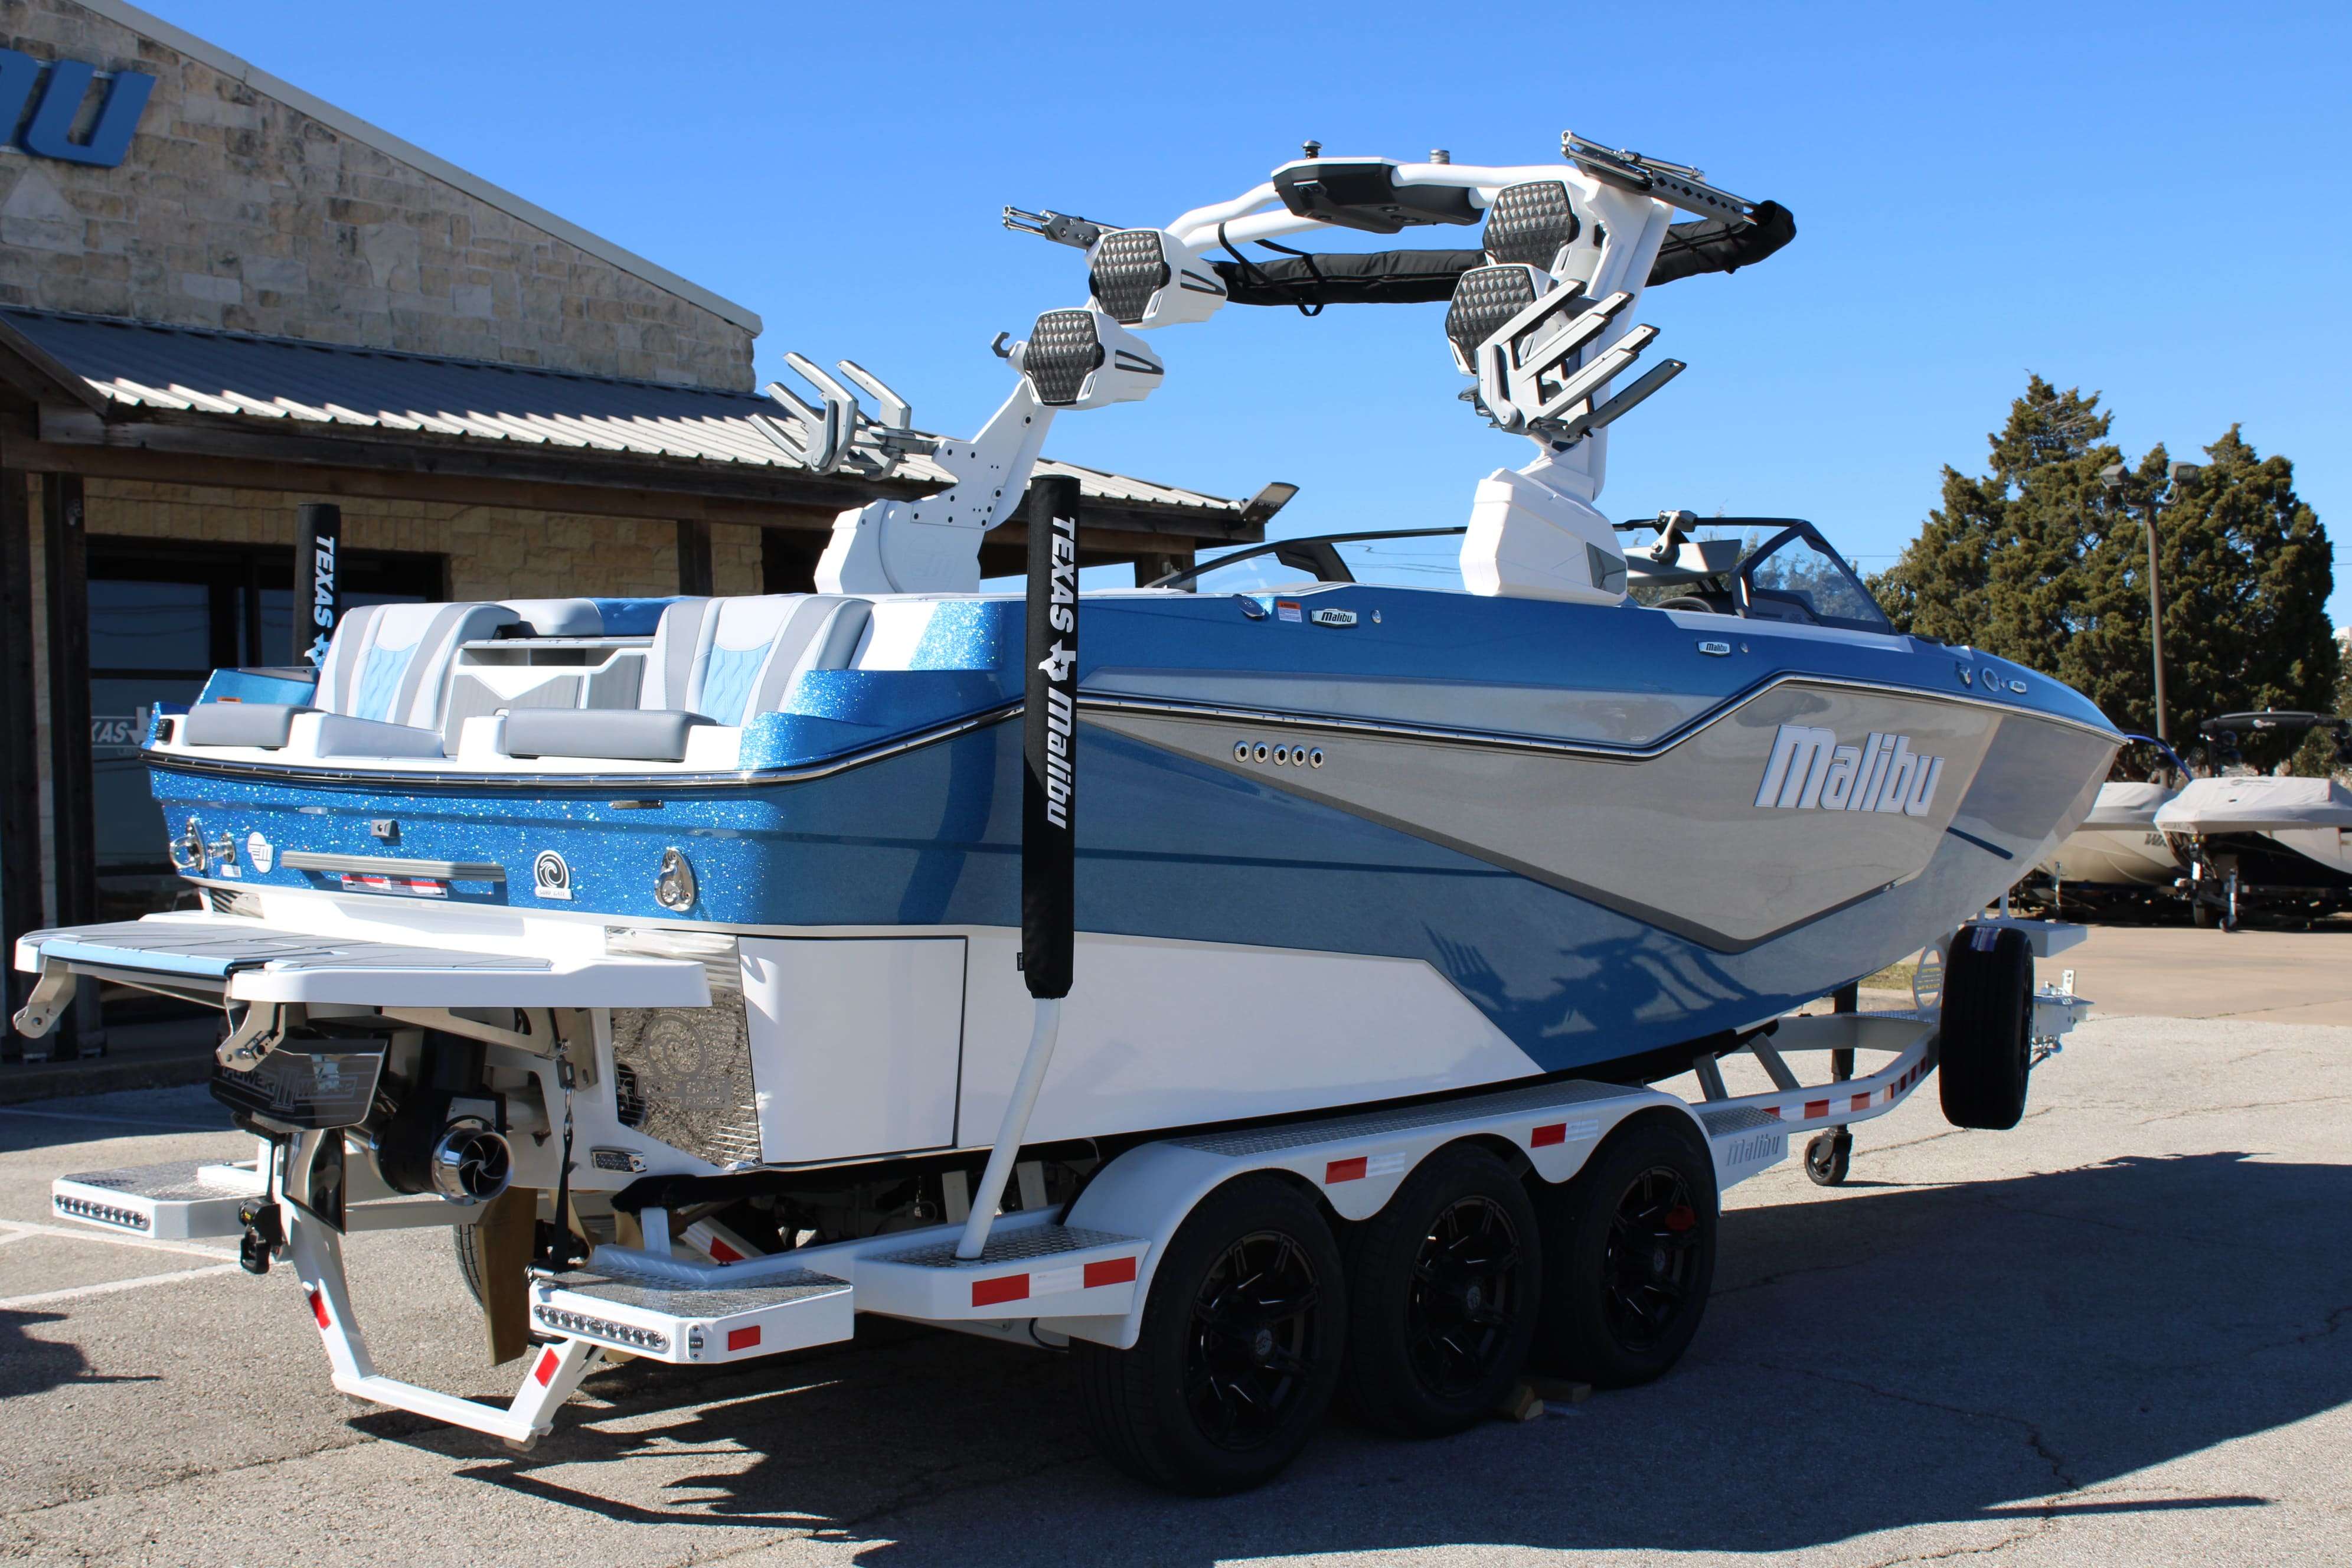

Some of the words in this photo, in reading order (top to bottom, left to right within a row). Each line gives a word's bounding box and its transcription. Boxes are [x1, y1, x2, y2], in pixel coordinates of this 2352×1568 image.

[313, 535, 335, 629] TEXAS
[1050, 517, 1075, 633] TEXAS
[1321, 612, 1353, 623] Malibu
[1706, 643, 1727, 652] Malibu
[1047, 686, 1072, 829] Malibu
[1753, 724, 1945, 816] Malibu
[1726, 1133, 1781, 1167] Malibu
